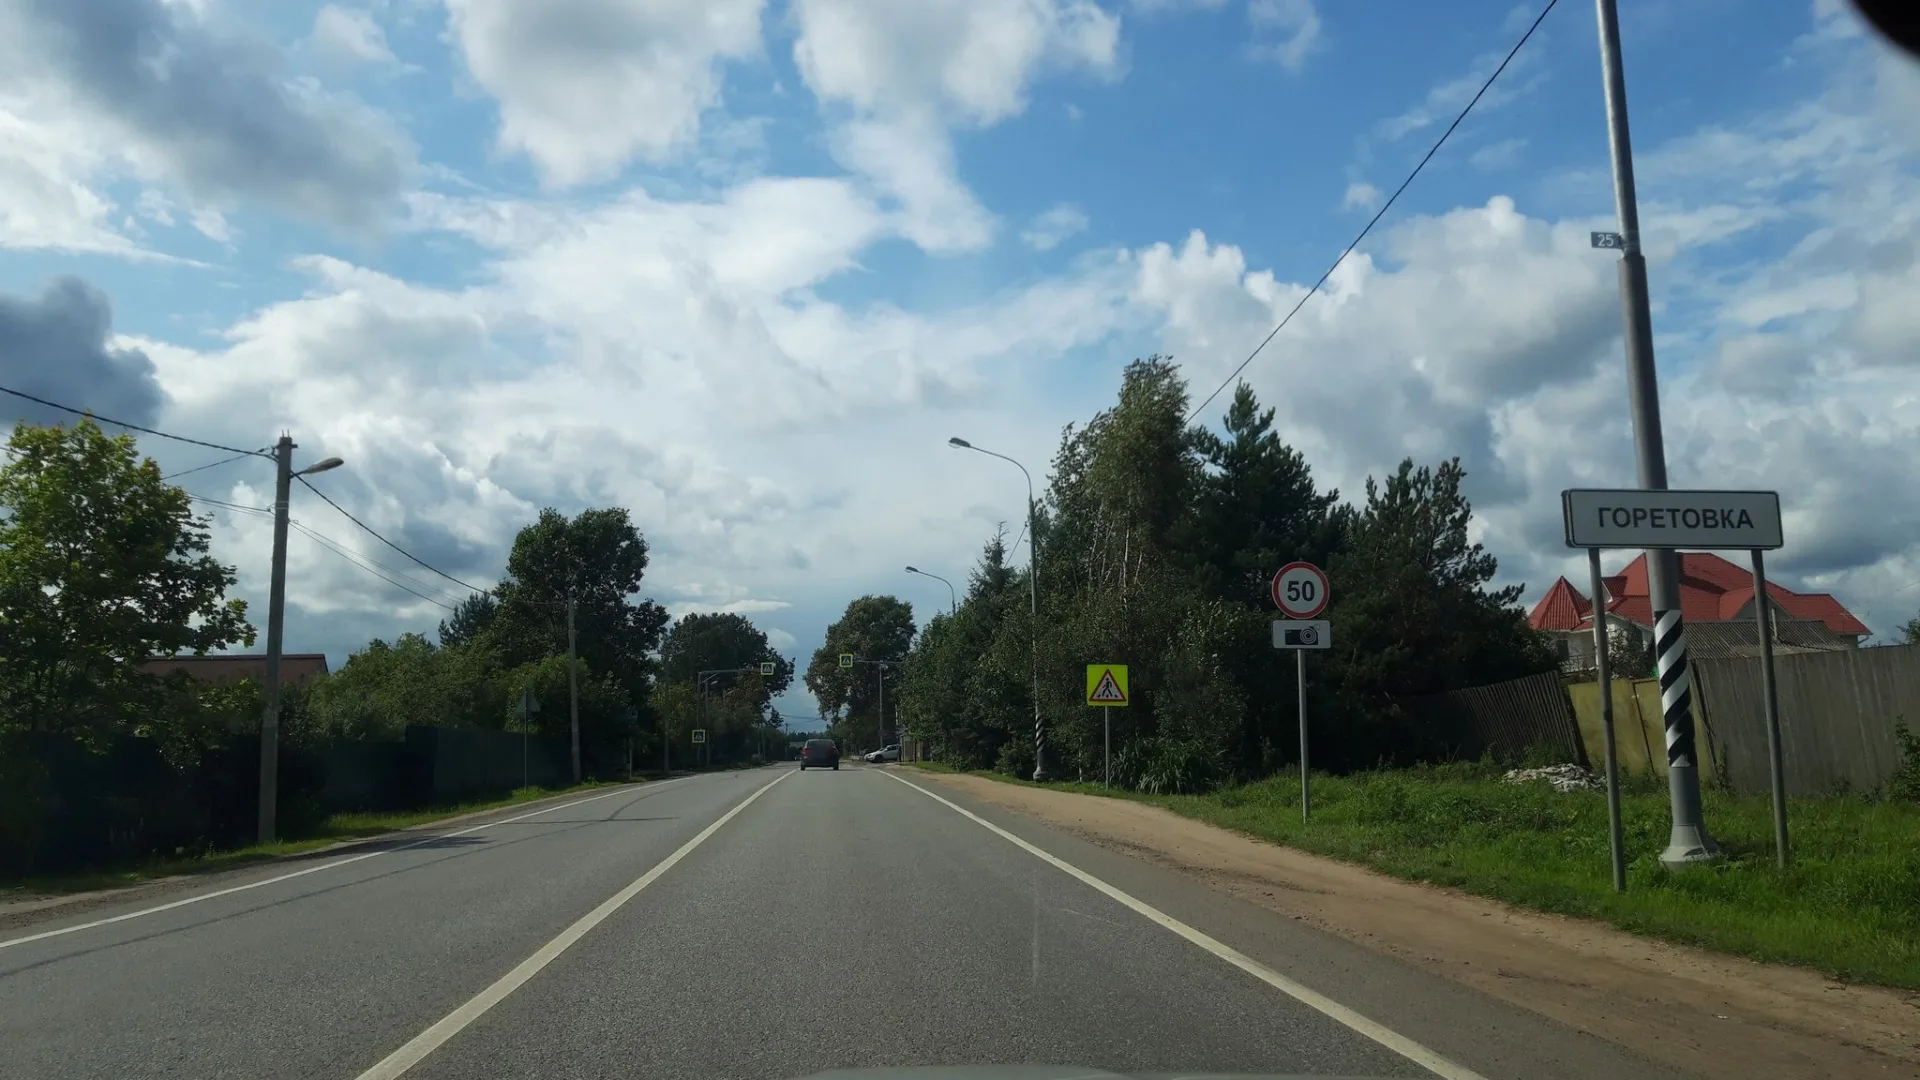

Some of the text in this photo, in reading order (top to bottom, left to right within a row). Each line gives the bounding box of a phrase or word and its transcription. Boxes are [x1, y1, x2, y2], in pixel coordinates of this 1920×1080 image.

[1597, 233, 1614, 247] 25
[1598, 507, 1755, 529] ГОРЕТОВКА
[1287, 580, 1315, 602] 50
